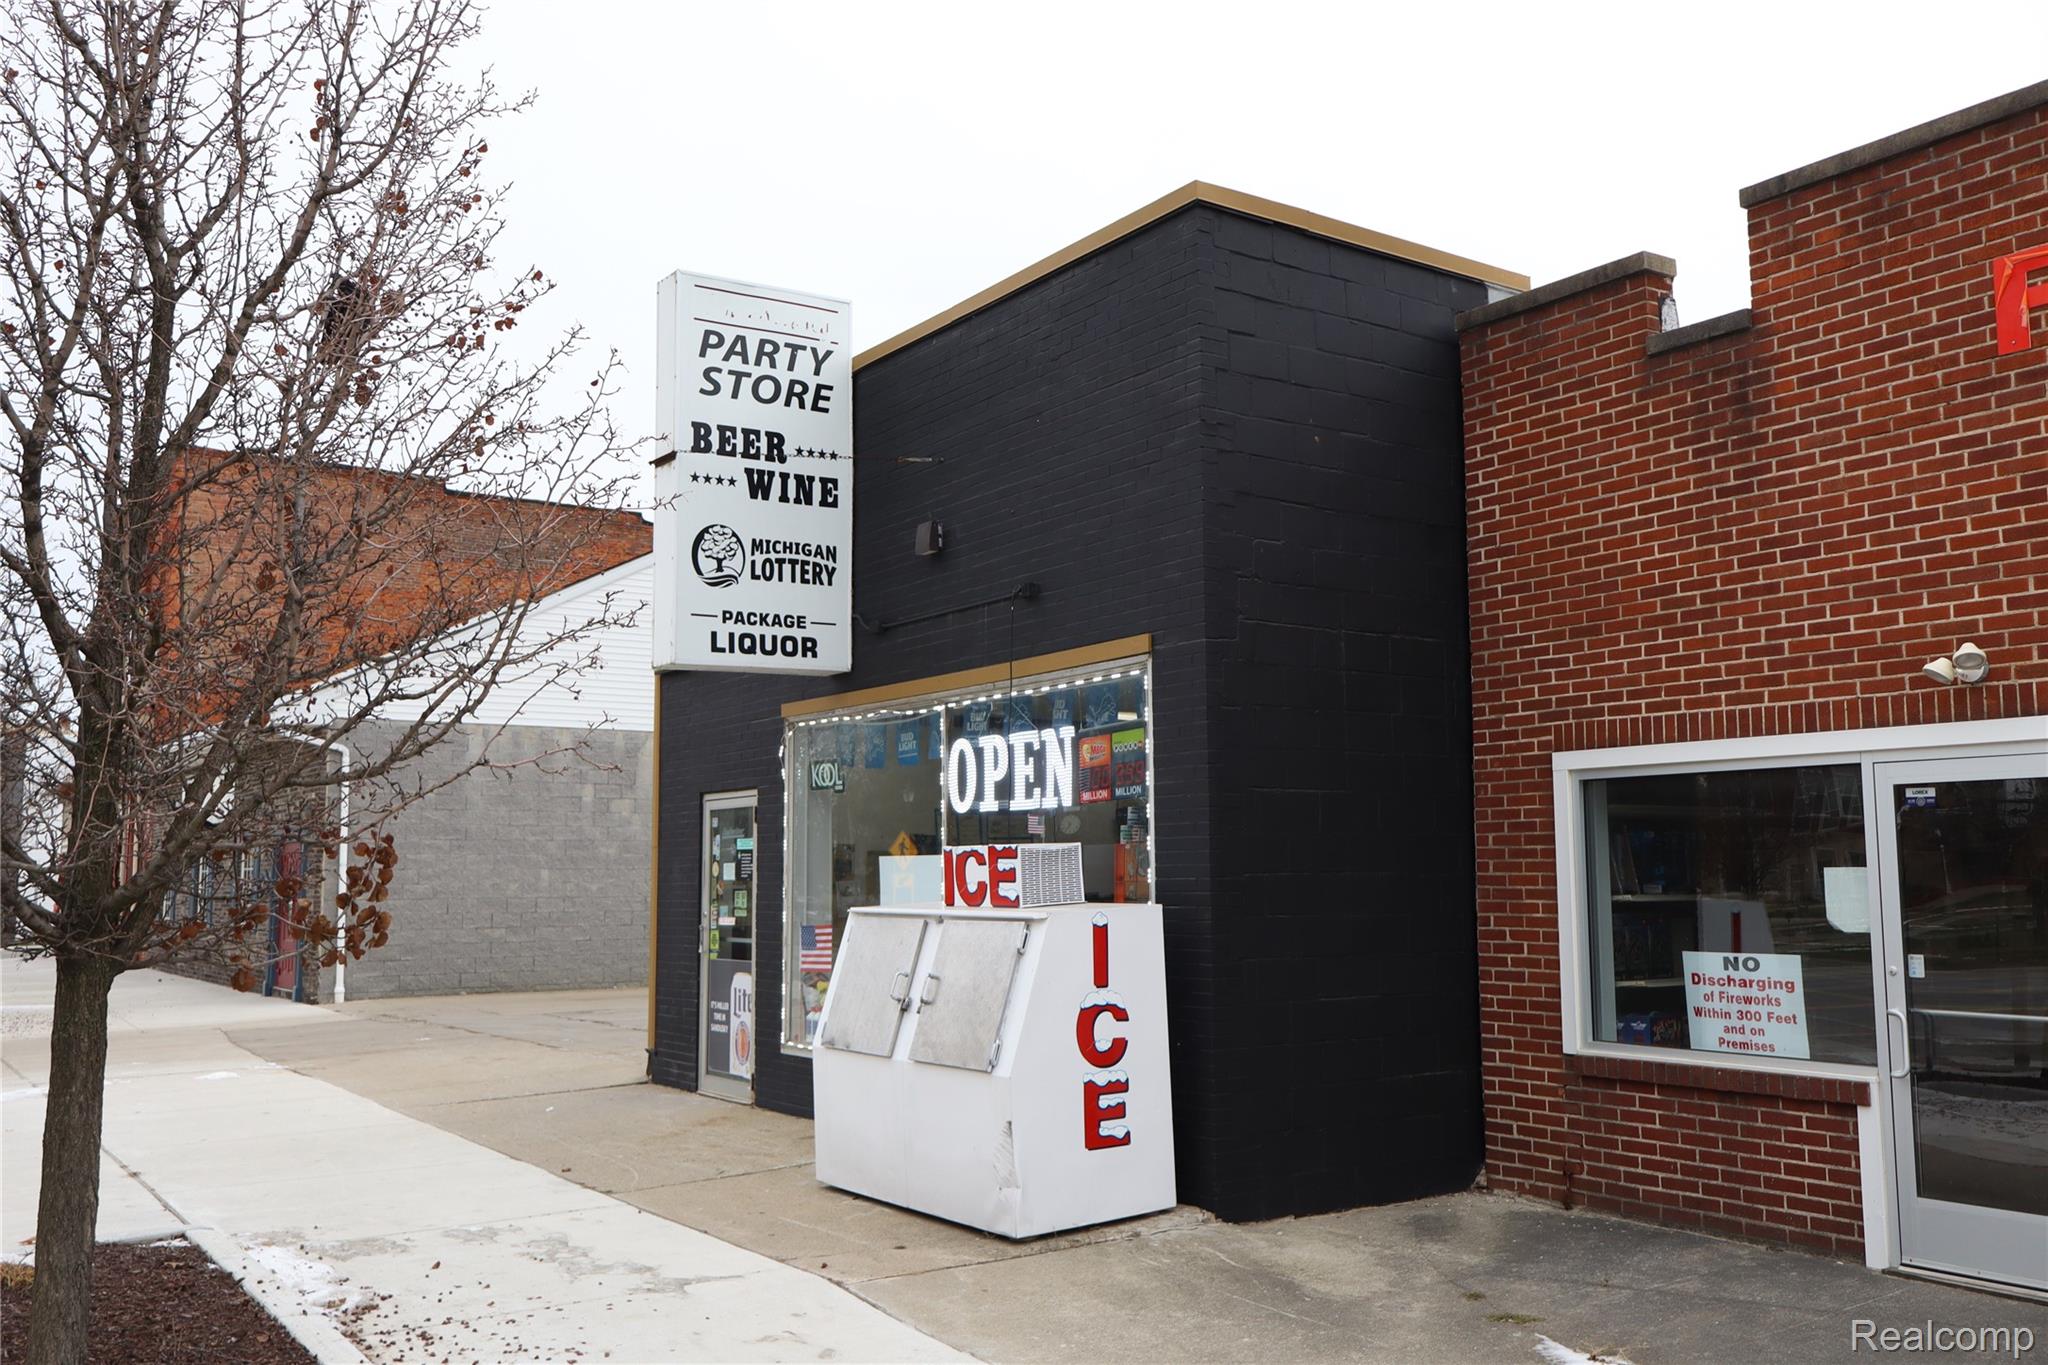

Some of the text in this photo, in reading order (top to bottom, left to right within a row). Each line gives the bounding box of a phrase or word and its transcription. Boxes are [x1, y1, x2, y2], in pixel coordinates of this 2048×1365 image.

[699, 329, 834, 376] PARTY
[699, 366, 834, 413] STORE
[691, 421, 787, 464] BEER
[744, 467, 838, 508] WINE
[751, 538, 837, 564] MICHIGAN
[751, 557, 837, 586] LOTTERY
[722, 610, 807, 629] PACKAGE
[711, 631, 818, 659] LIQUOR
[898, 740, 917, 752] LIGHT
[901, 731, 914, 742] BUD
[811, 762, 843, 788] KOOL
[948, 726, 1075, 813] OPEN
[1083, 789, 1108, 801] MILLION
[1115, 785, 1142, 797] MILLION
[943, 845, 1020, 908] ICE
[1723, 956, 1760, 972] NO
[1691, 972, 1795, 994] Discharging
[1703, 990, 1782, 1007] of Fireworks
[1693, 1006, 1798, 1025] Within 300 Feet
[1076, 911, 1131, 1151] ICE
[1723, 1024, 1765, 1037] and on
[1718, 1037, 1776, 1053] Premises
